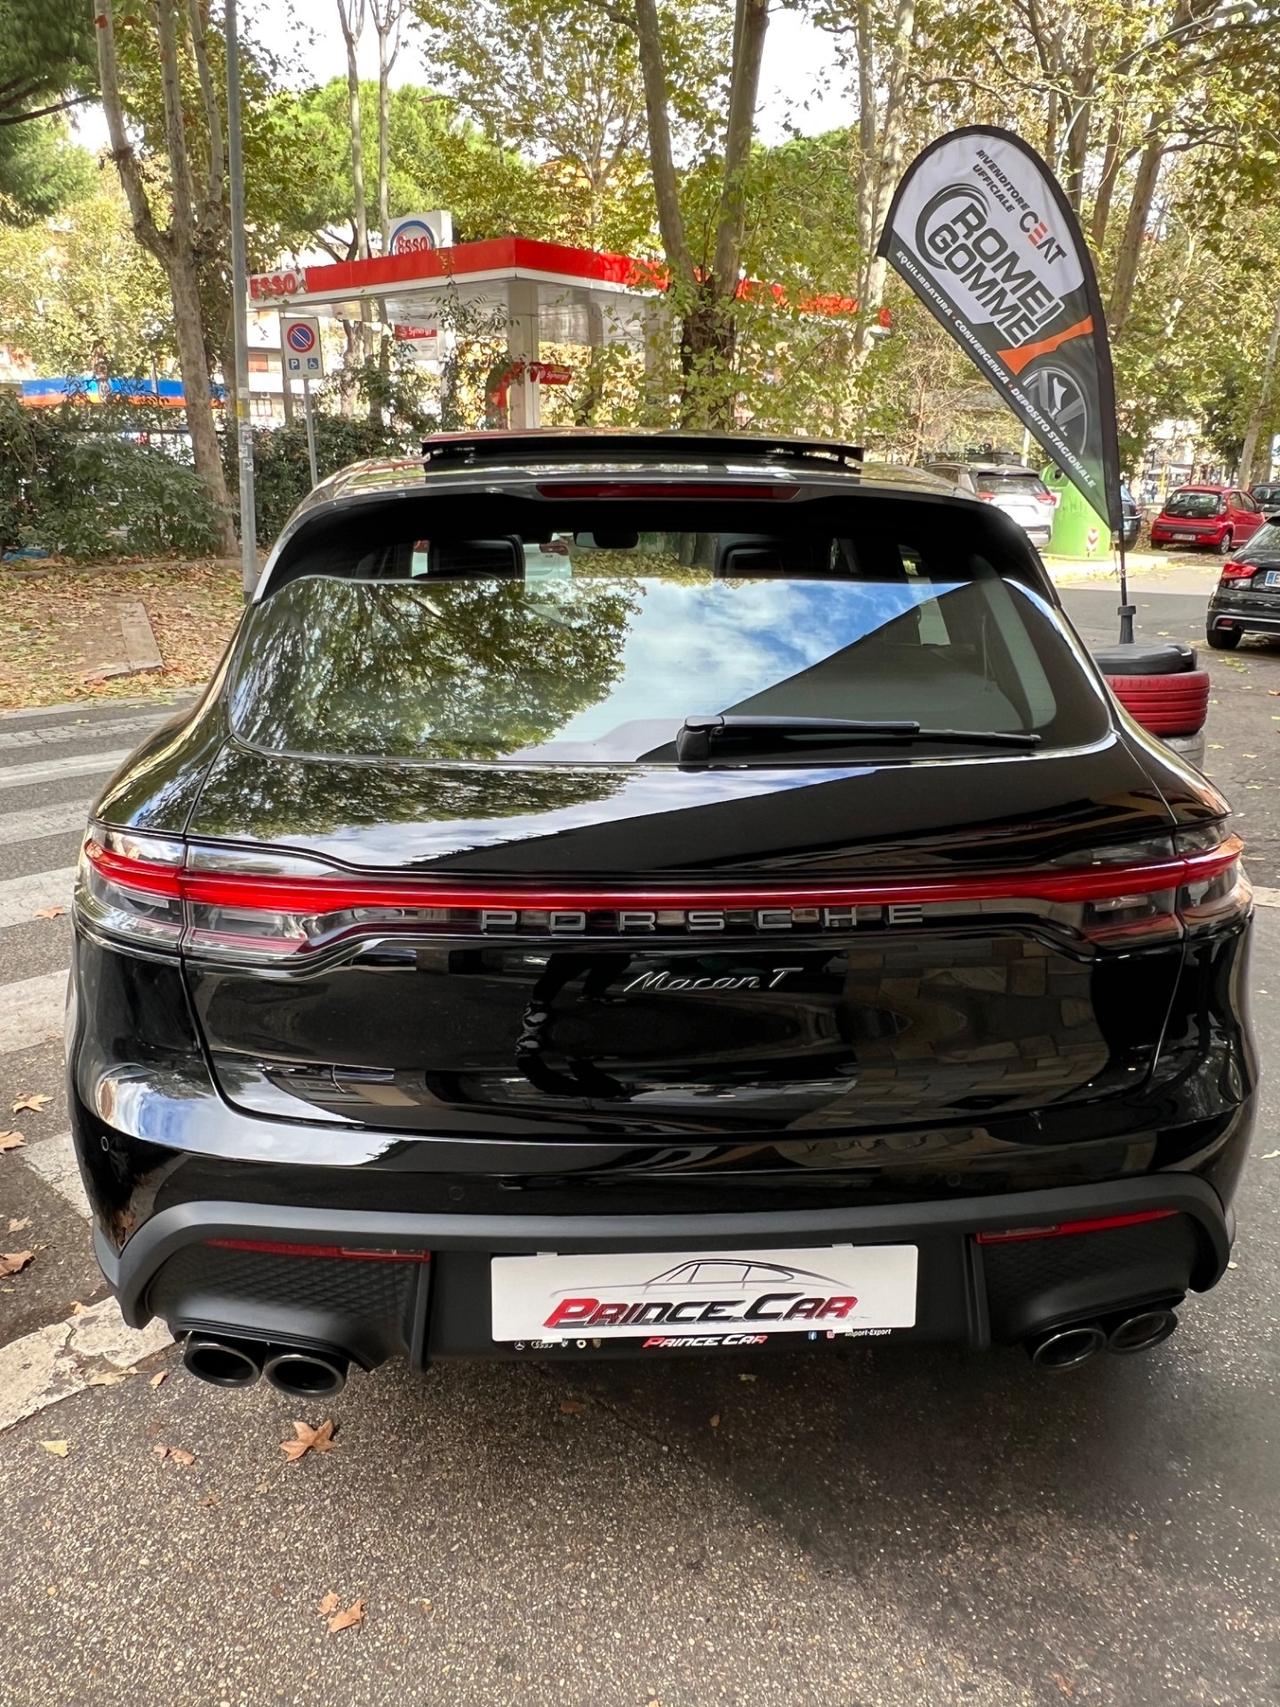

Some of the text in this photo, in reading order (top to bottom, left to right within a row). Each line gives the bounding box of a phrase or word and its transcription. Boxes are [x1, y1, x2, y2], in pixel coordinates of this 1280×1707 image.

[972, 163, 1015, 213] UFFICIALE
[976, 149, 1031, 211] RIVENDITORE
[1019, 210, 1067, 264] CEAT
[928, 223, 1039, 346] GOMME
[896, 251, 1097, 488] EQUILIBRATURA CONVERGENZA DEPOSITO STAGIONALE
[480, 904, 923, 932] PORSCHE
[623, 967, 804, 992] Macan T
[543, 1292, 858, 1328] PRINCE CAR
[642, 1334, 768, 1348] PRINCE CAR
